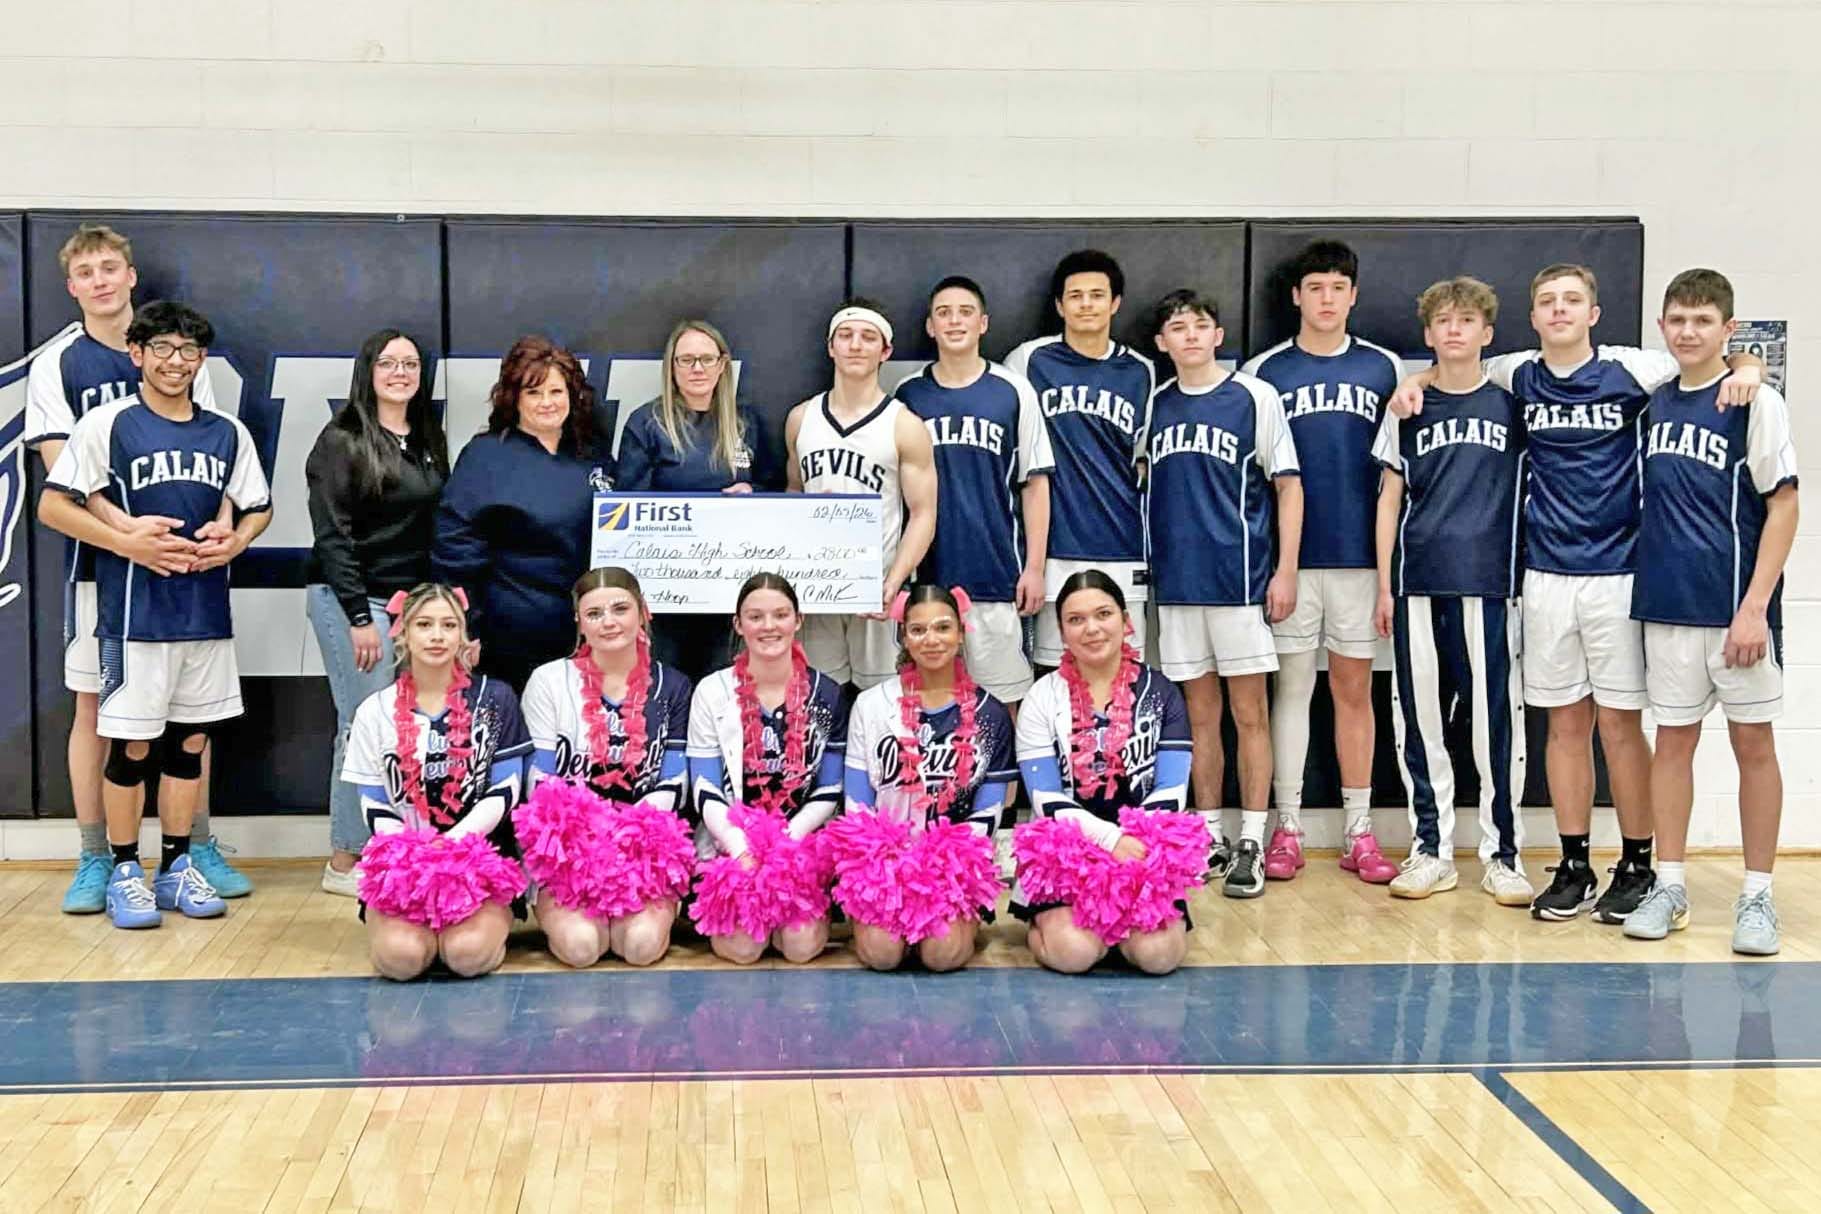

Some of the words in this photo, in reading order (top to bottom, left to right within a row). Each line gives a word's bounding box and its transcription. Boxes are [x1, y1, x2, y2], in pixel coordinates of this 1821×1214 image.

[1042, 385, 1136, 434] CALAIS
[1280, 383, 1379, 423] CALAIS
[1524, 403, 1624, 431] CALAIS
[924, 415, 1004, 455] ALAIS
[1152, 423, 1239, 464] CALAIS
[1416, 417, 1508, 456] CALAIS
[1645, 421, 1729, 471] ALAIS
[801, 447, 886, 493] DEVILS
[635, 502, 692, 521] First
[623, 540, 681, 559] Calais
[688, 541, 724, 566] High
[734, 541, 787, 560] School
